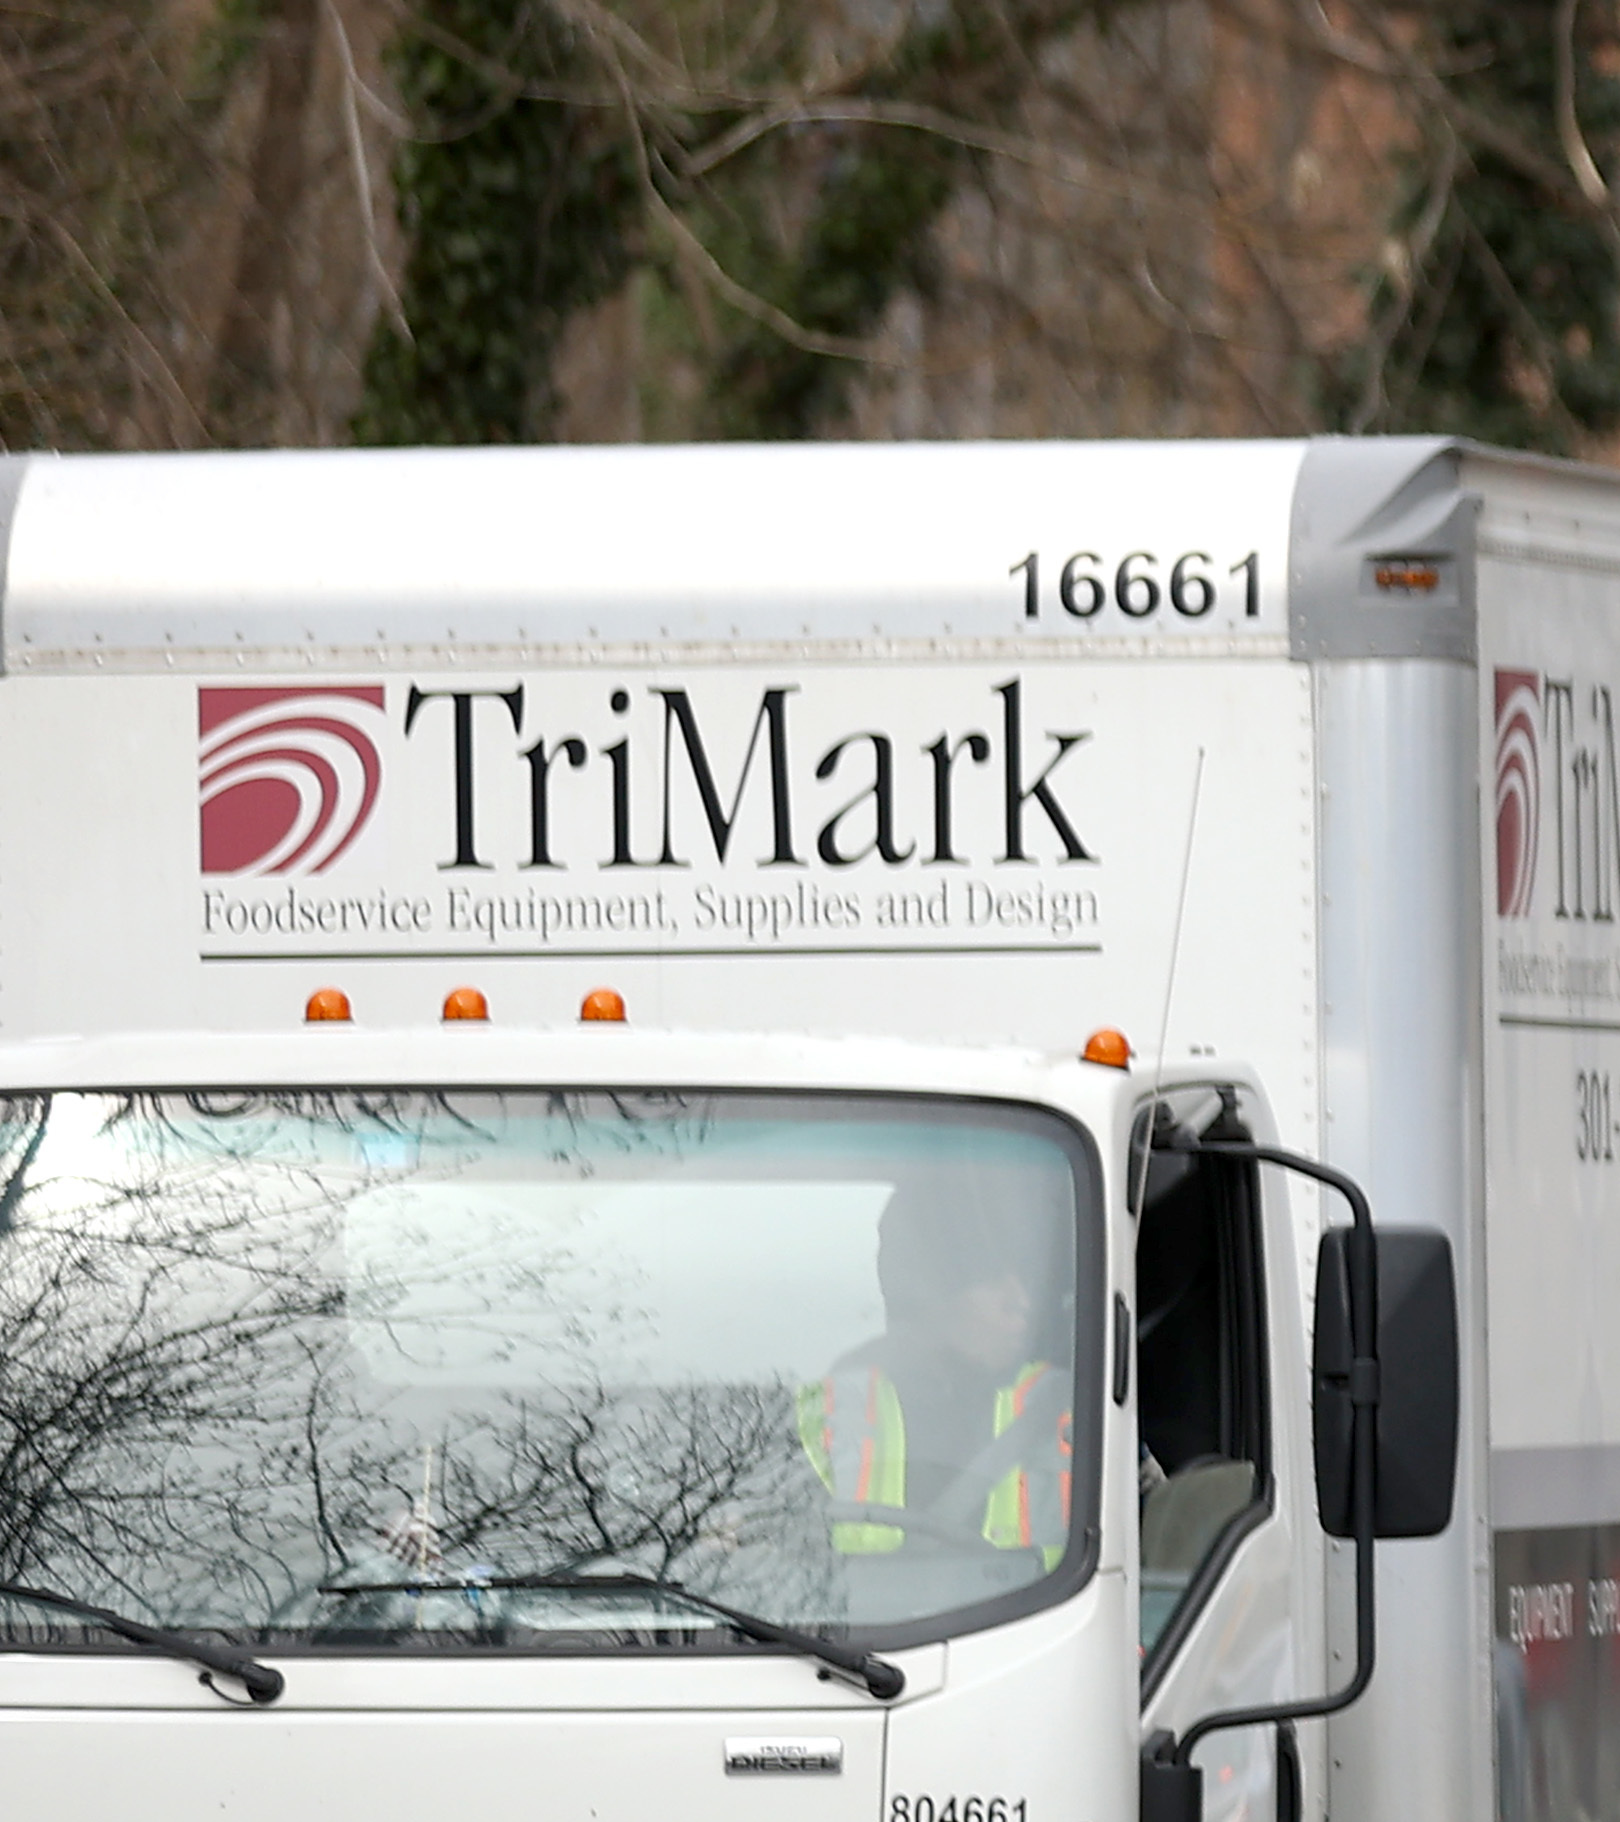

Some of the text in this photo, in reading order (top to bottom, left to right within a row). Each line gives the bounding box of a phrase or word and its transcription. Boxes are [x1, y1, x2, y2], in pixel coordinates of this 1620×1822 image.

[1008, 551, 1261, 618] 16661
[403, 673, 1094, 872] TriMark
[202, 879, 1098, 943] Foodservice Equipment, Supplies and Design
[729, 1754, 840, 1774] DIESEL
